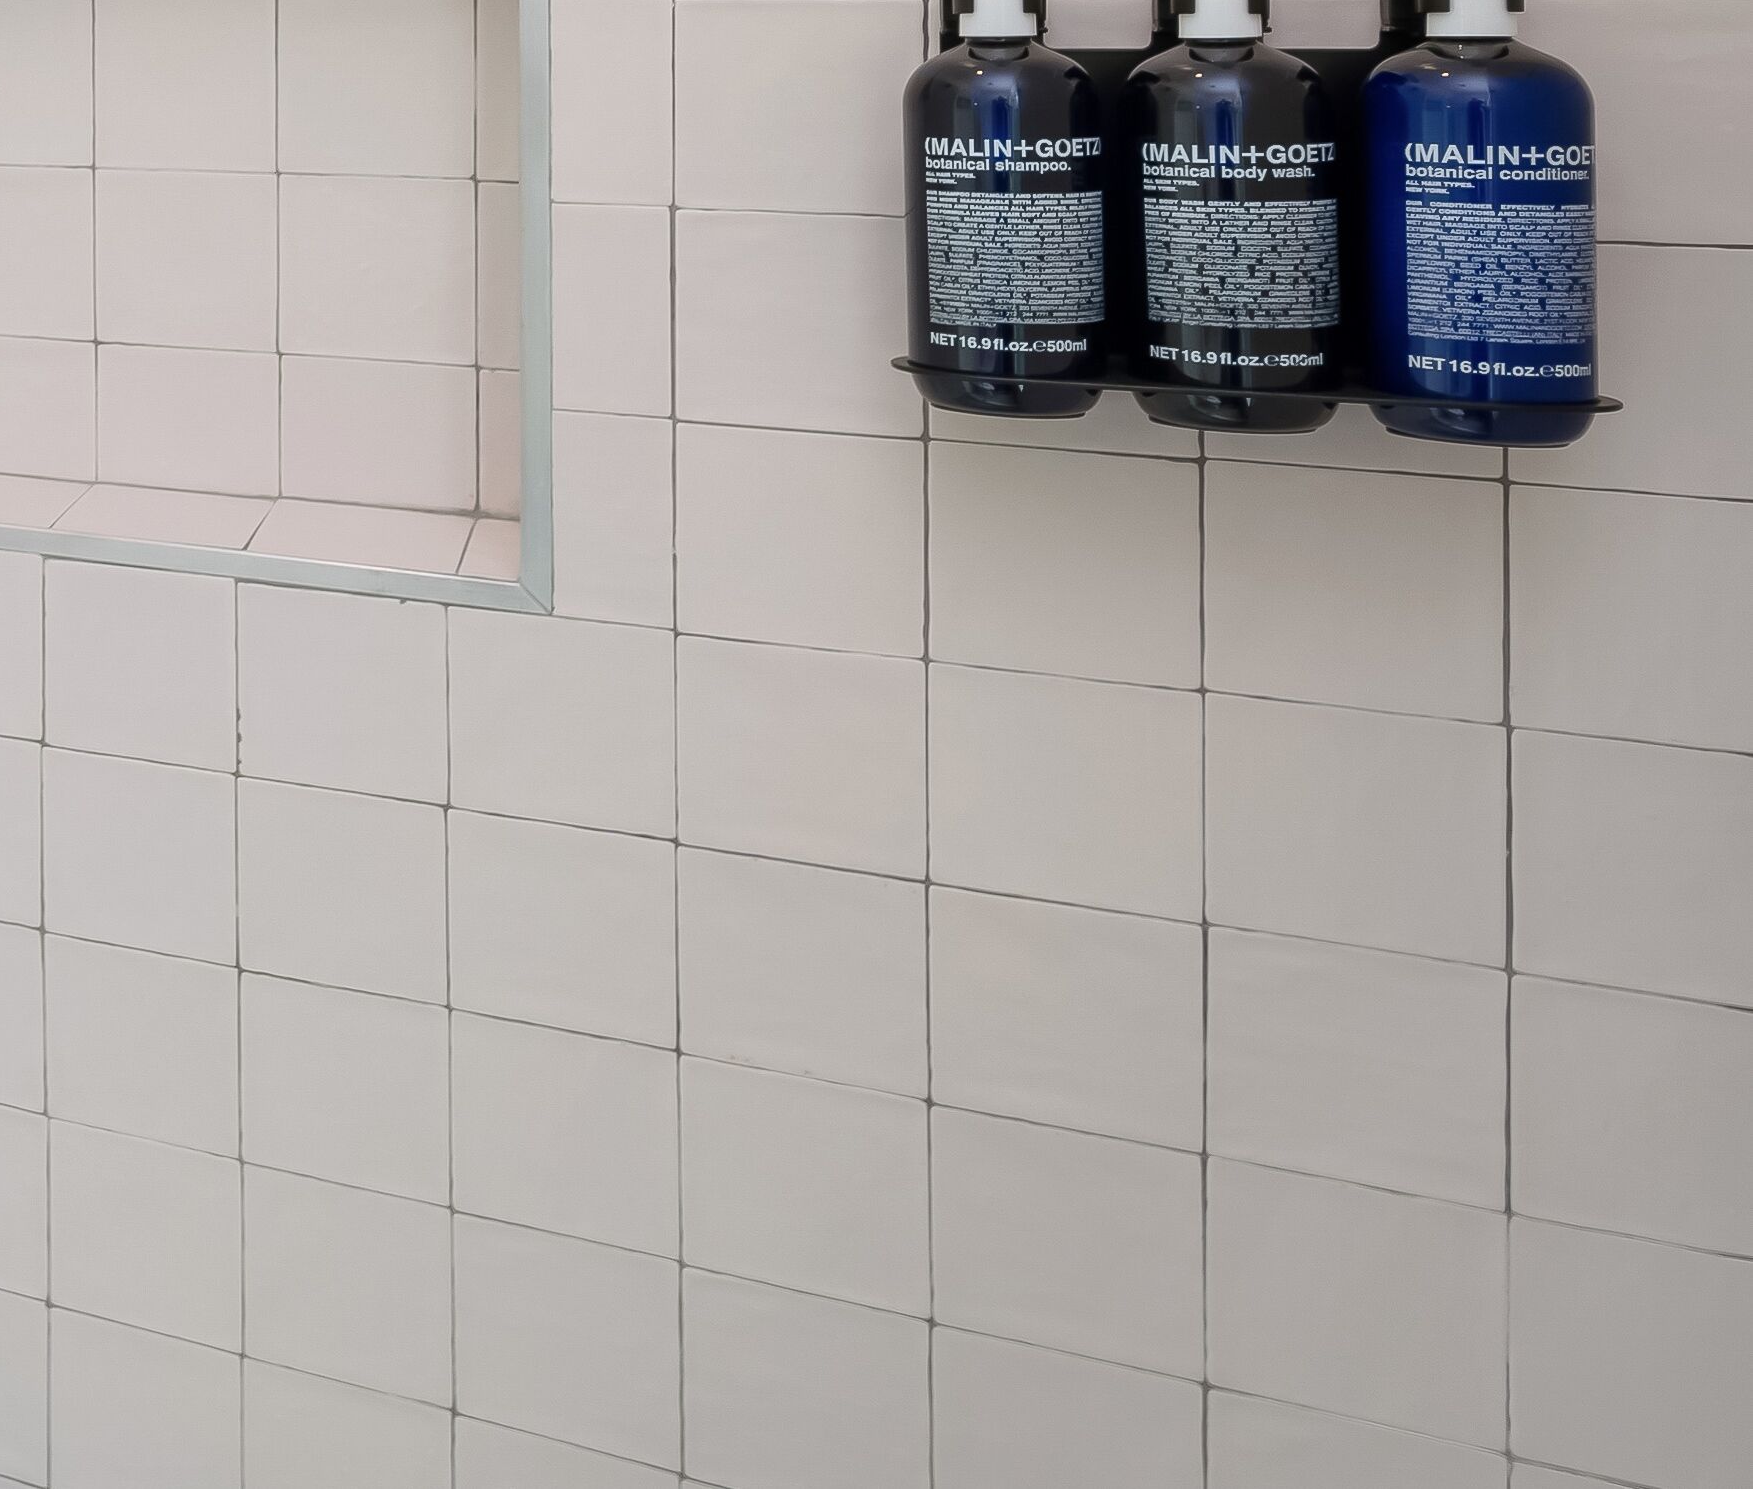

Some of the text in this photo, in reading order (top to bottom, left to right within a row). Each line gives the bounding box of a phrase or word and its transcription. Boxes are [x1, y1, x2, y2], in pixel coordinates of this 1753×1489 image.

[925, 156, 1072, 174] botanical shampoo.
[1143, 163, 1316, 182] botanical body wash.
[1406, 164, 1590, 181] botanical conditioner.
[930, 332, 957, 347] NET
[1150, 345, 1179, 360] NET
[1408, 355, 1446, 370] NET
[1448, 359, 1491, 375] 16.9
